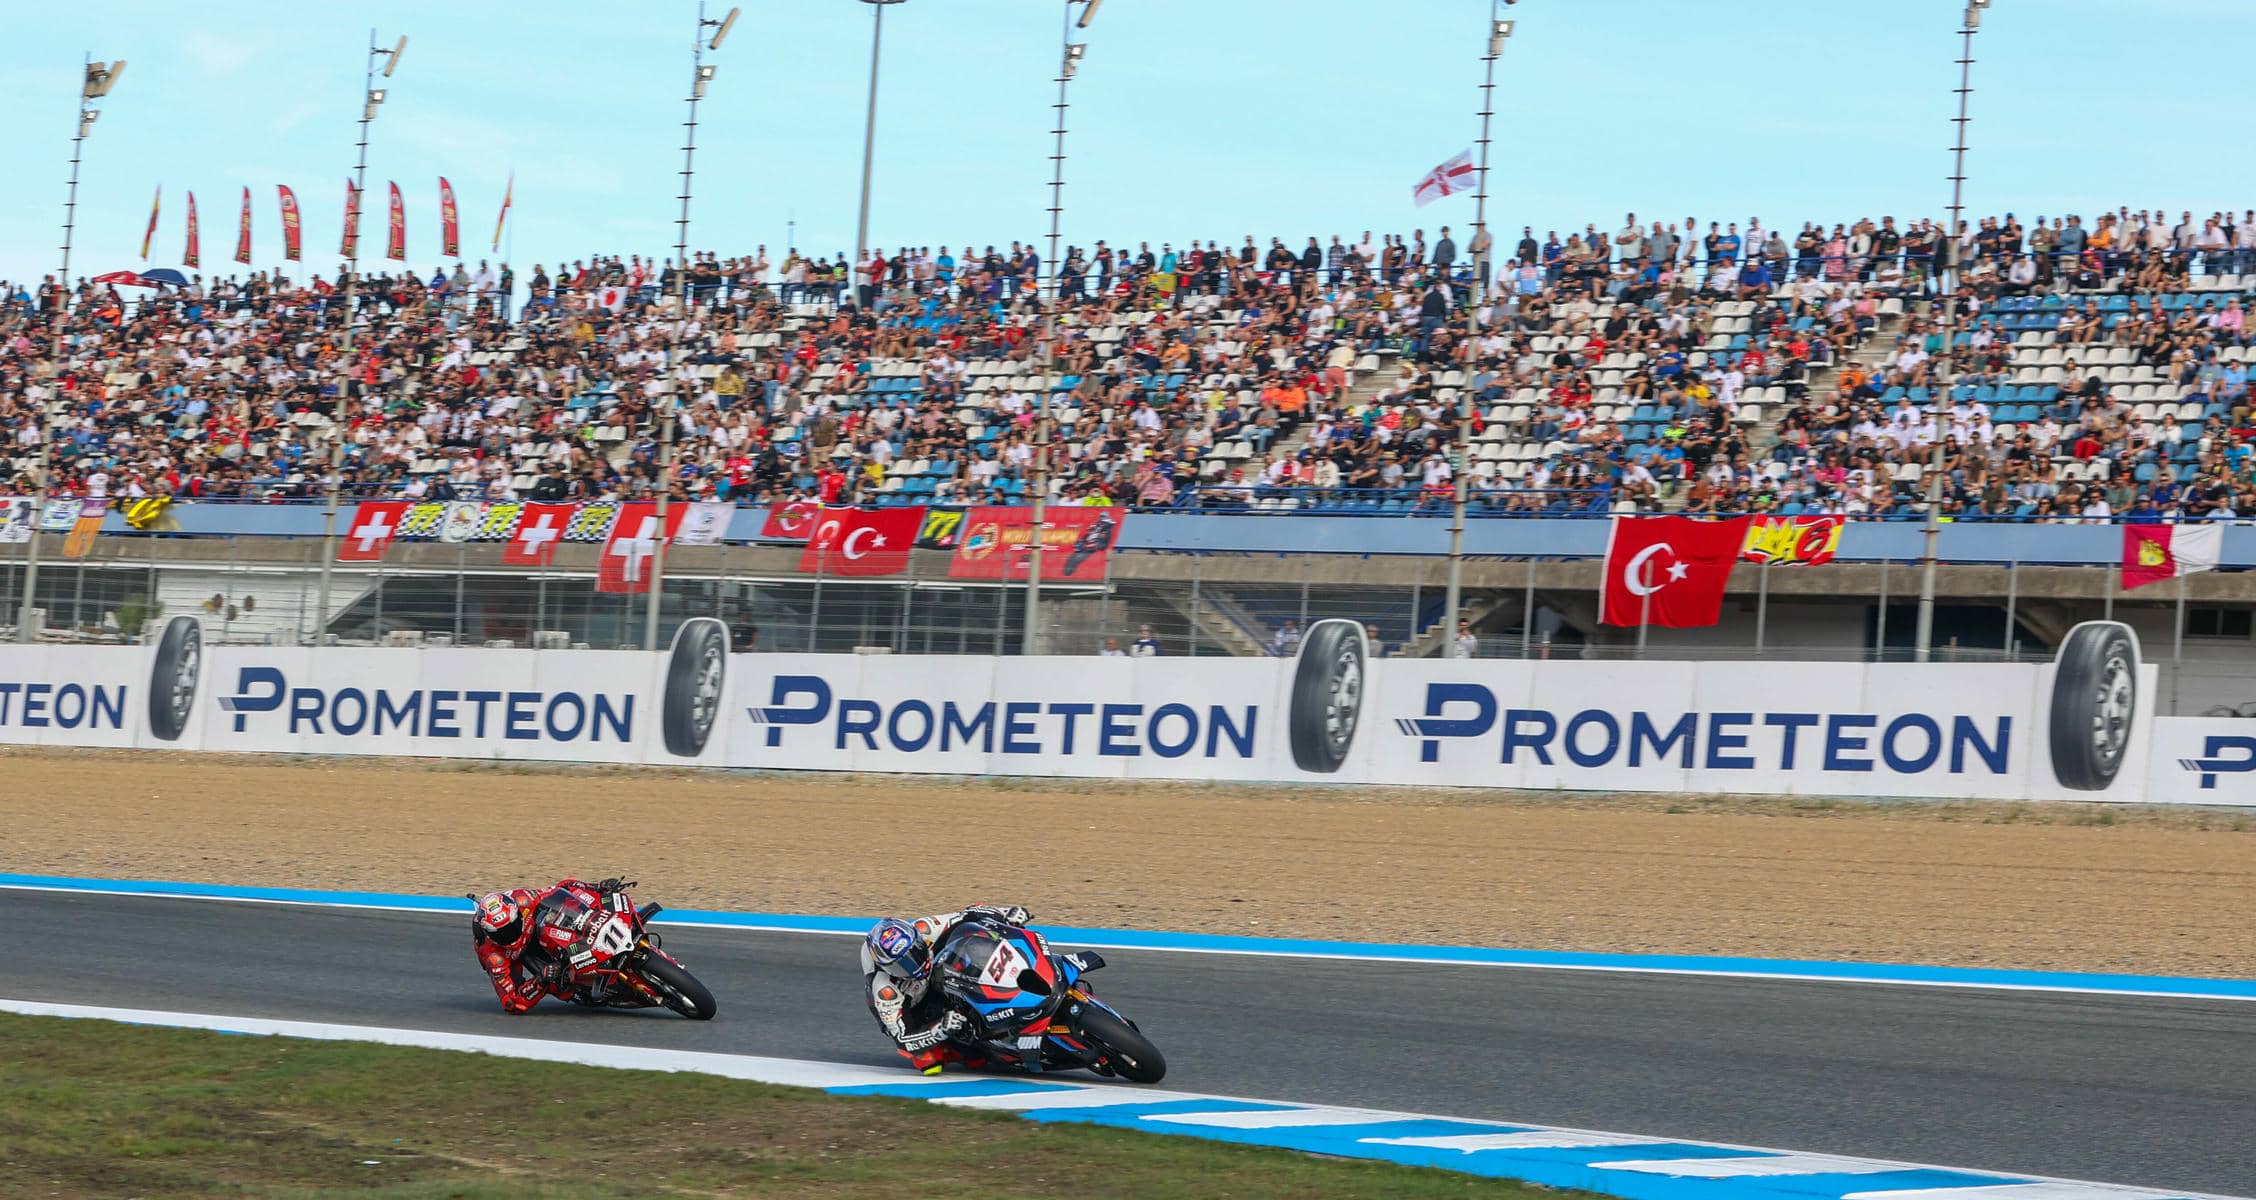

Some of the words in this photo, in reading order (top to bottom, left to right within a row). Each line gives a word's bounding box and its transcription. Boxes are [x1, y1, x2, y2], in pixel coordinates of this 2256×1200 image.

[409, 503, 445, 531] 77
[483, 504, 521, 532] 77
[923, 511, 962, 541] 77
[0, 683, 127, 729] TEON
[220, 667, 634, 742] PROMETEON
[750, 676, 1258, 759] PROMETEON
[1398, 683, 2013, 775] PROMETEON
[604, 924, 625, 950] 11
[988, 945, 1014, 984] 54
[904, 1036, 938, 1052] ROKIT
